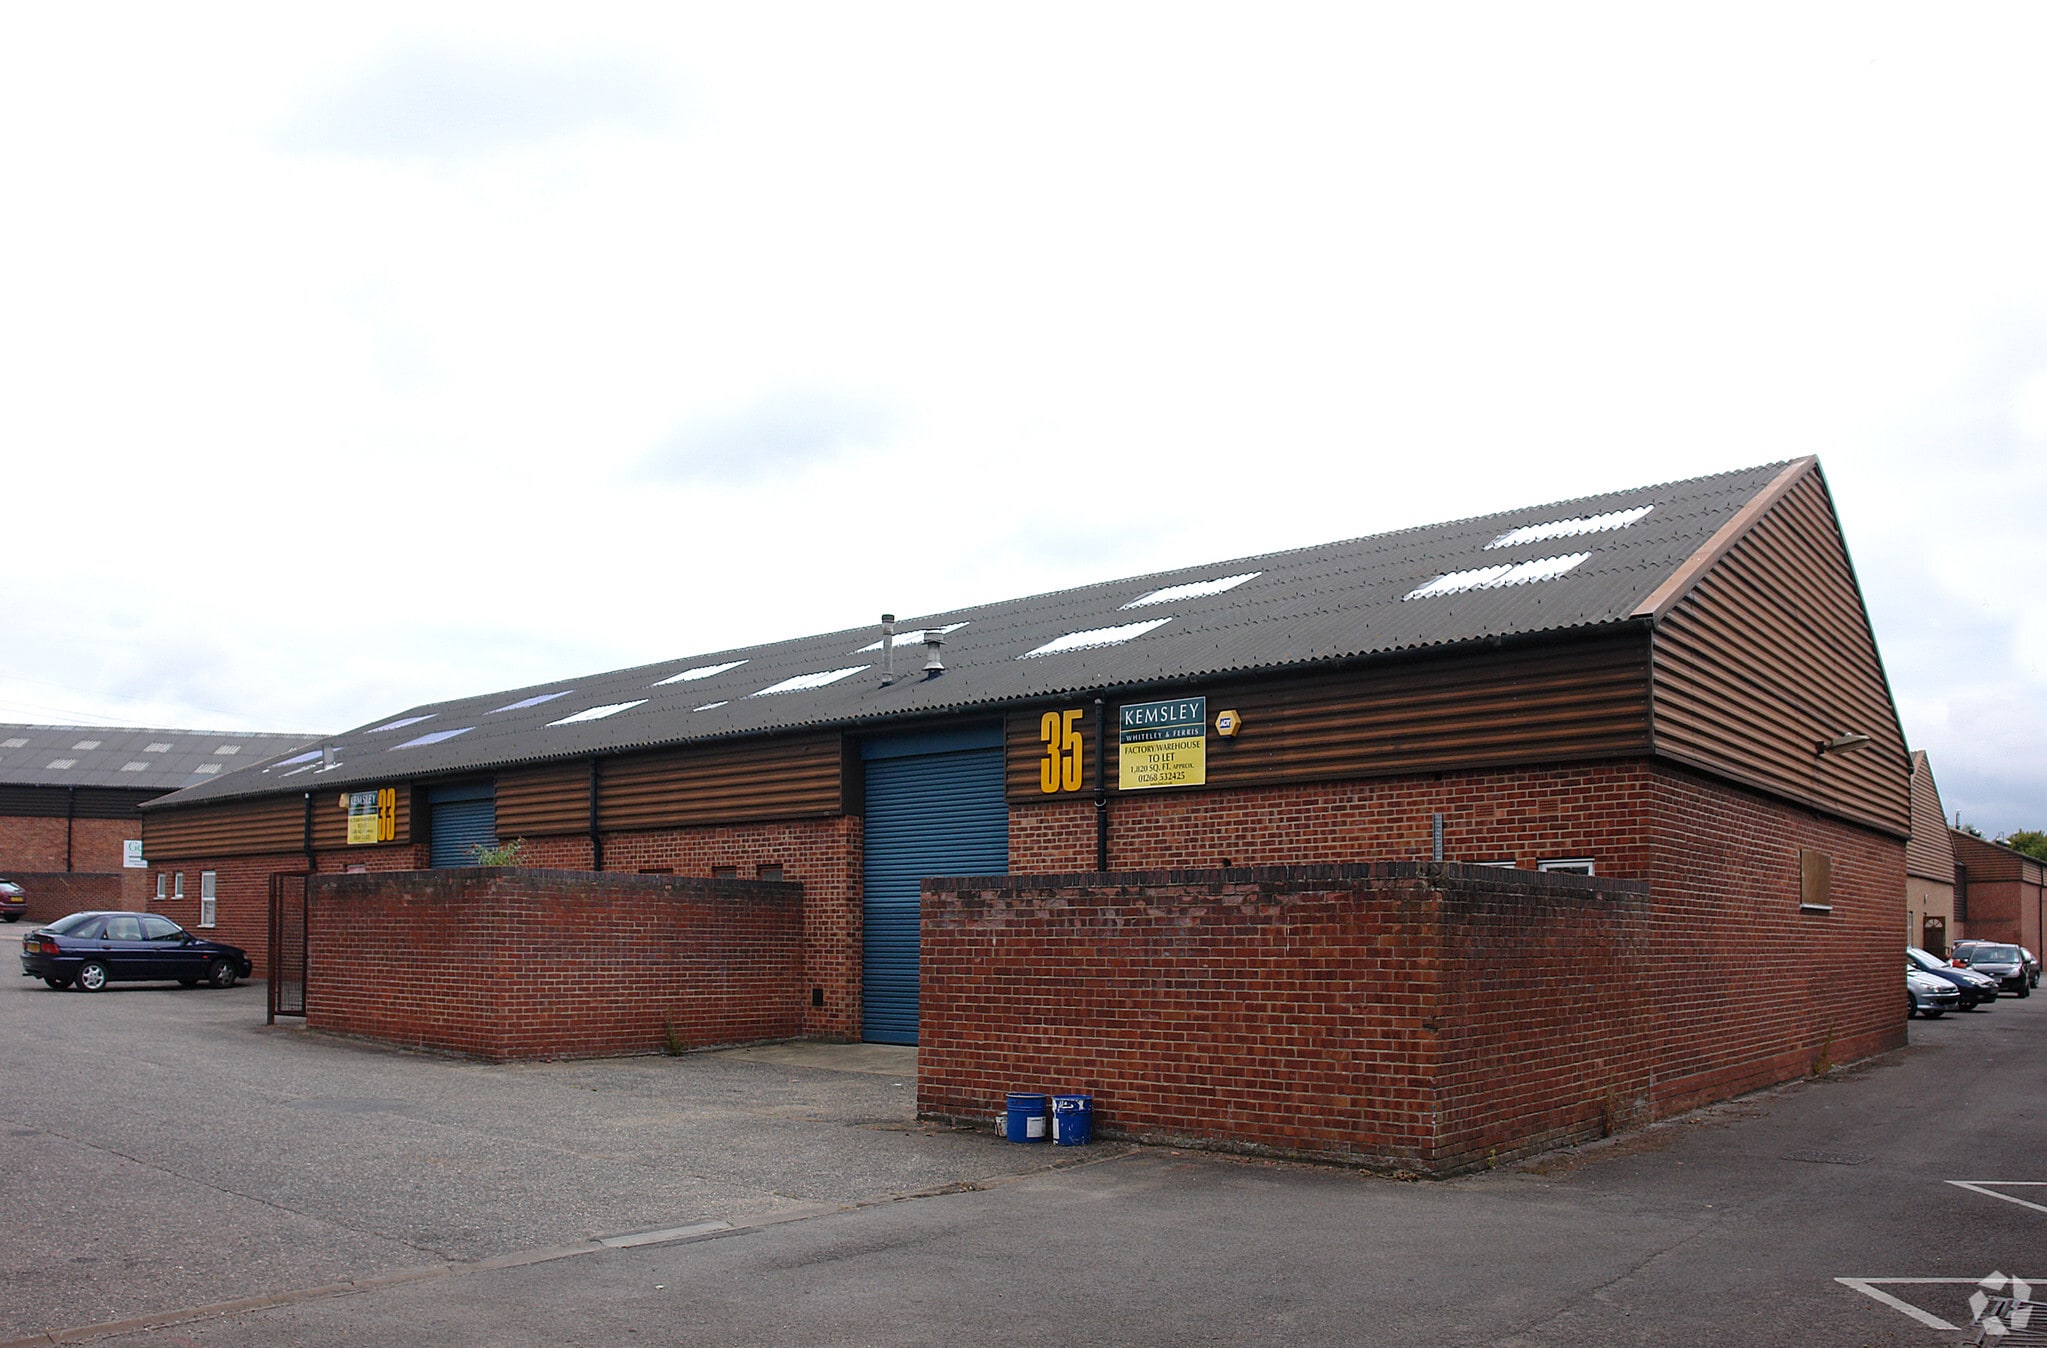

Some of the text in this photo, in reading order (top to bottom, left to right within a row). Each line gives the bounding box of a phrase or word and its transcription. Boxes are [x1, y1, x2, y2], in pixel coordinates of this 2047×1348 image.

[1125, 703, 1199, 726] KEMSLEY
[1126, 728, 1199, 742] WHITELEY & FERRIS
[1040, 708, 1083, 794] 35
[1148, 752, 1175, 763] TO LET
[1149, 763, 1161, 772] SQ.
[1162, 763, 1171, 771] FT.
[1138, 771, 1185, 783] 01268 532425
[351, 794, 375, 805] KEMSLEY
[378, 787, 396, 841] 33
